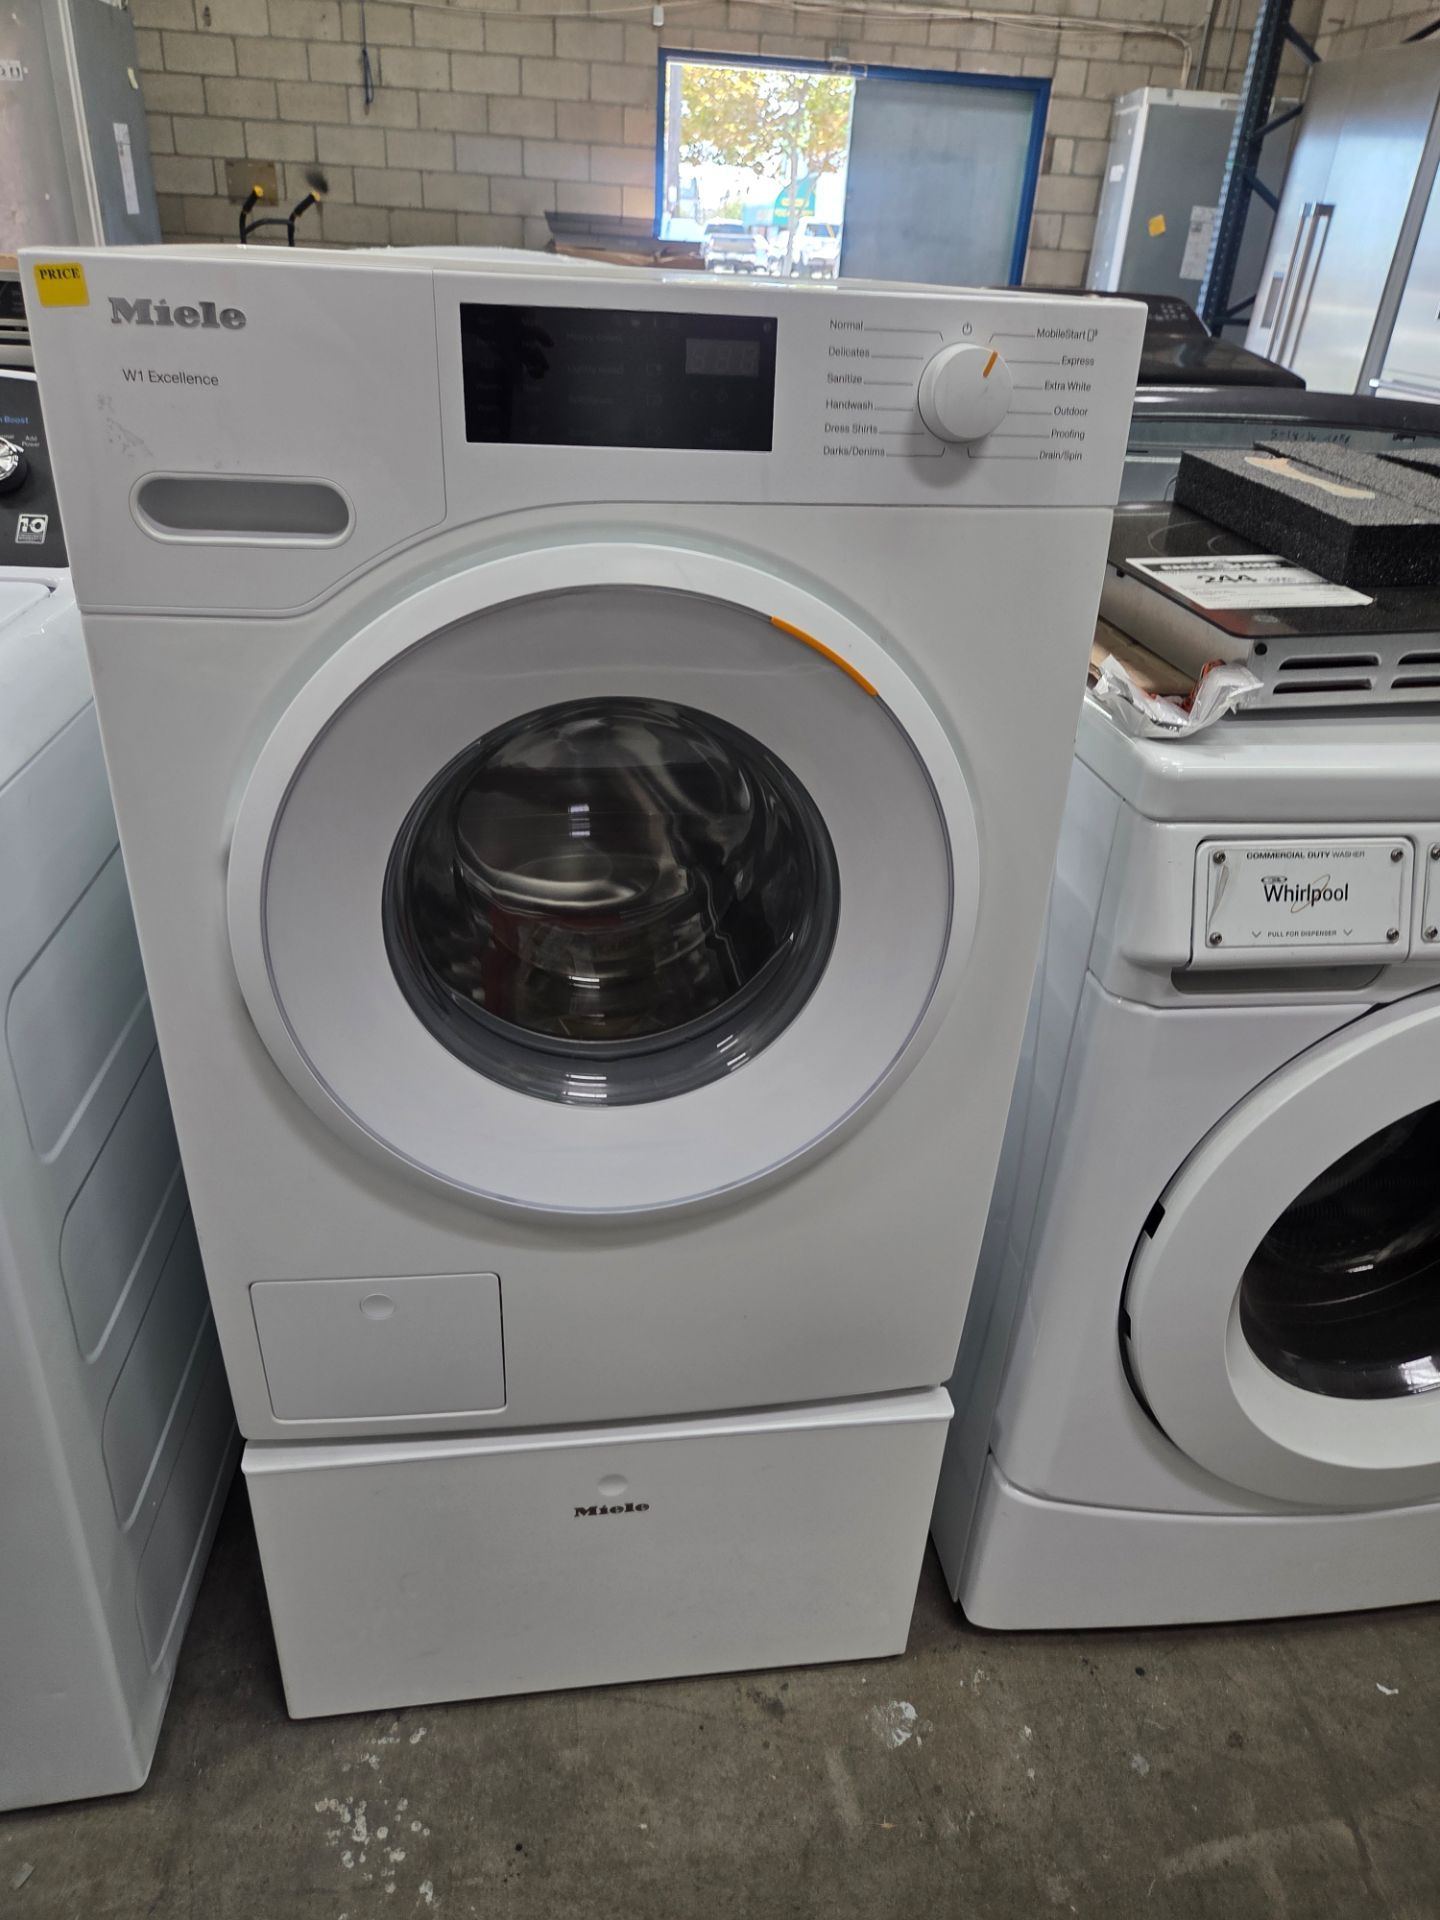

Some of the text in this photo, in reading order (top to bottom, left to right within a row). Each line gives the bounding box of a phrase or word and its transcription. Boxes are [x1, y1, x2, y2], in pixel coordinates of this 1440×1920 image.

[39, 267, 80, 281] PRICE
[109, 296, 247, 330] Miele
[829, 320, 863, 331] Normal
[1036, 328, 1086, 340] MobileStart
[828, 347, 870, 358] Delicates
[1061, 356, 1094, 368] Express
[122, 369, 219, 386] W1 Excellence
[827, 374, 862, 385] Sanitize
[1044, 381, 1091, 392] Extra White
[825, 400, 873, 411] Handwash
[1054, 406, 1088, 417] Outdoor
[824, 424, 878, 435] Dress Shirts
[1051, 430, 1085, 441] Proofing
[1039, 450, 1083, 462] Drain/Spin
[1246, 851, 1365, 860] COMMERCIAL DUTY WASHER
[1263, 884, 1349, 907] Whirlpool
[1300, 929, 1337, 937] DISPENSER
[574, 1502, 650, 1518] Miele
